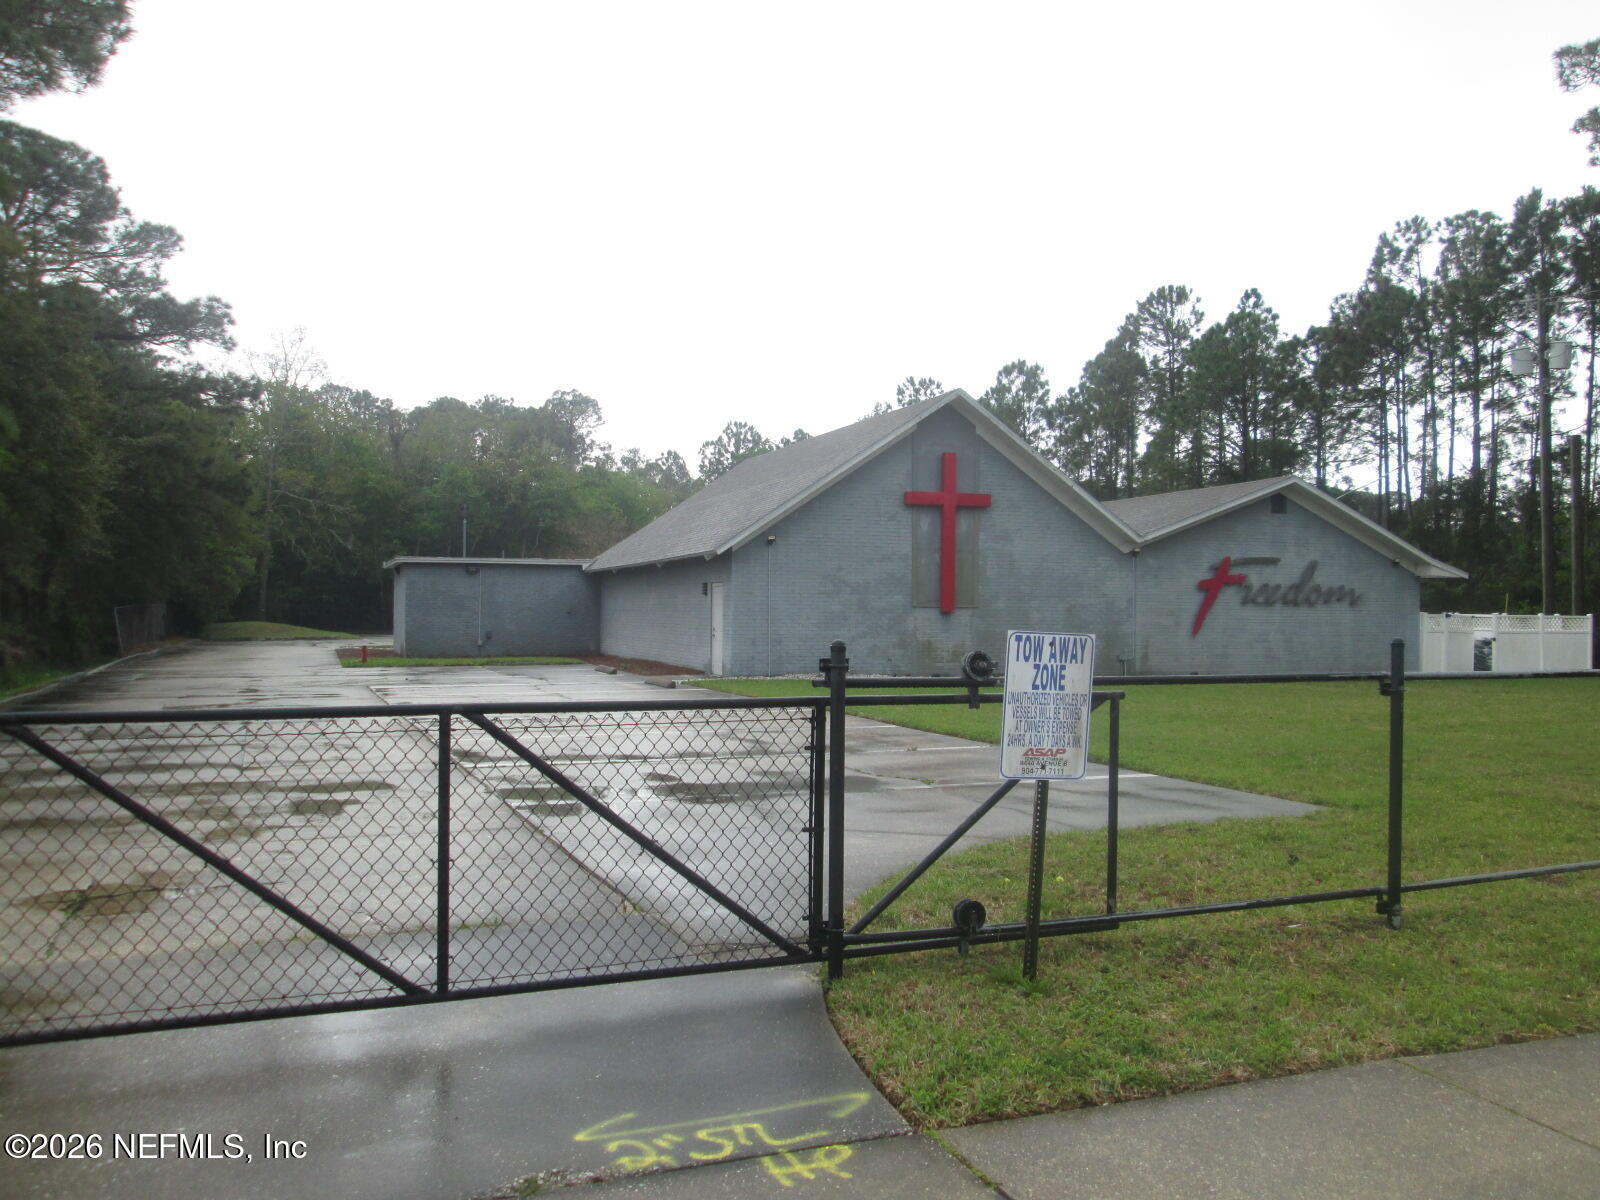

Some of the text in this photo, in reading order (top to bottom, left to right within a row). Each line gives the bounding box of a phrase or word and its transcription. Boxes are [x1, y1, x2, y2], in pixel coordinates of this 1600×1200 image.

[1191, 555, 1362, 638] Freedom
[1015, 635, 1088, 664] TOW AWAY
[1032, 664, 1066, 691] ZONE
[1008, 692, 1087, 706] UNAUTHORIZED VEHICLES OR
[1012, 706, 1082, 721] VESSELS WILL BE TOWED
[1015, 720, 1077, 734] AT OWNER'S EXPENSE
[1028, 735, 1032, 747] A
[1033, 735, 1045, 747] DAY
[1051, 735, 1066, 748] DAYS
[1067, 736, 1071, 748] A
[1023, 748, 1066, 757] ASAP
